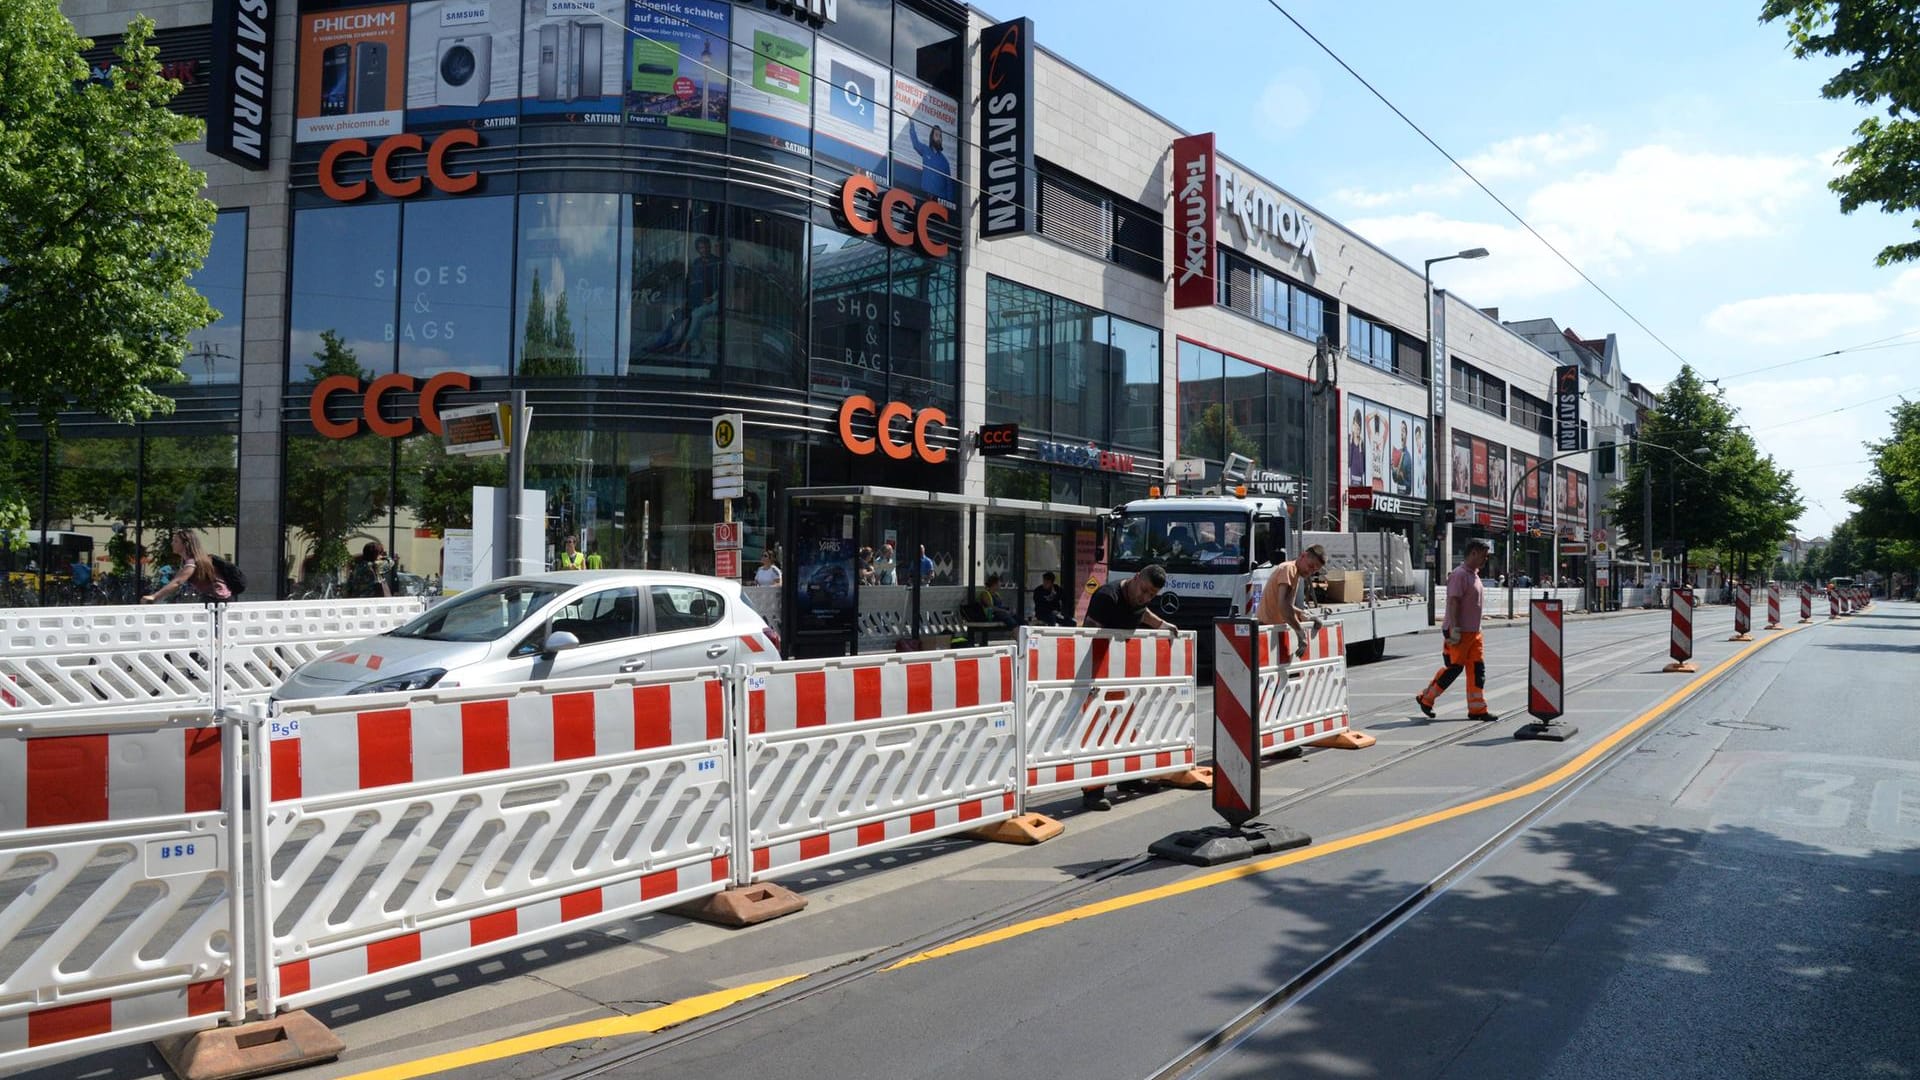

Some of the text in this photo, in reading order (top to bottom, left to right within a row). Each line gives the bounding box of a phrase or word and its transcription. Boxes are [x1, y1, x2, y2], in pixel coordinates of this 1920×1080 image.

[552, 0, 596, 10] SAMSUNG
[683, 6, 724, 21] schaltet
[313, 12, 395, 33] PHICOMM
[446, 10, 485, 21] SAMSUNG
[634, 14, 652, 23] auf
[232, 0, 268, 160] SATURN
[310, 117, 390, 132] www.phicomm.de
[484, 117, 517, 128] SATURN
[584, 113, 621, 124] SATURN
[318, 129, 480, 200] CCC
[987, 91, 1017, 232] SATURN
[842, 174, 949, 258] CCC
[414, 293, 433, 314] &
[837, 297, 901, 327] SHOS
[865, 327, 878, 346] &
[309, 371, 470, 439] CCC
[839, 395, 946, 464] CCC
[1560, 393, 1577, 450] SATURN
[983, 430, 1013, 443] CCC
[1370, 494, 1400, 513] TIGER
[1203, 580, 1215, 591] KG
[271, 720, 299, 736] BSG
[161, 843, 195, 860] BSG
